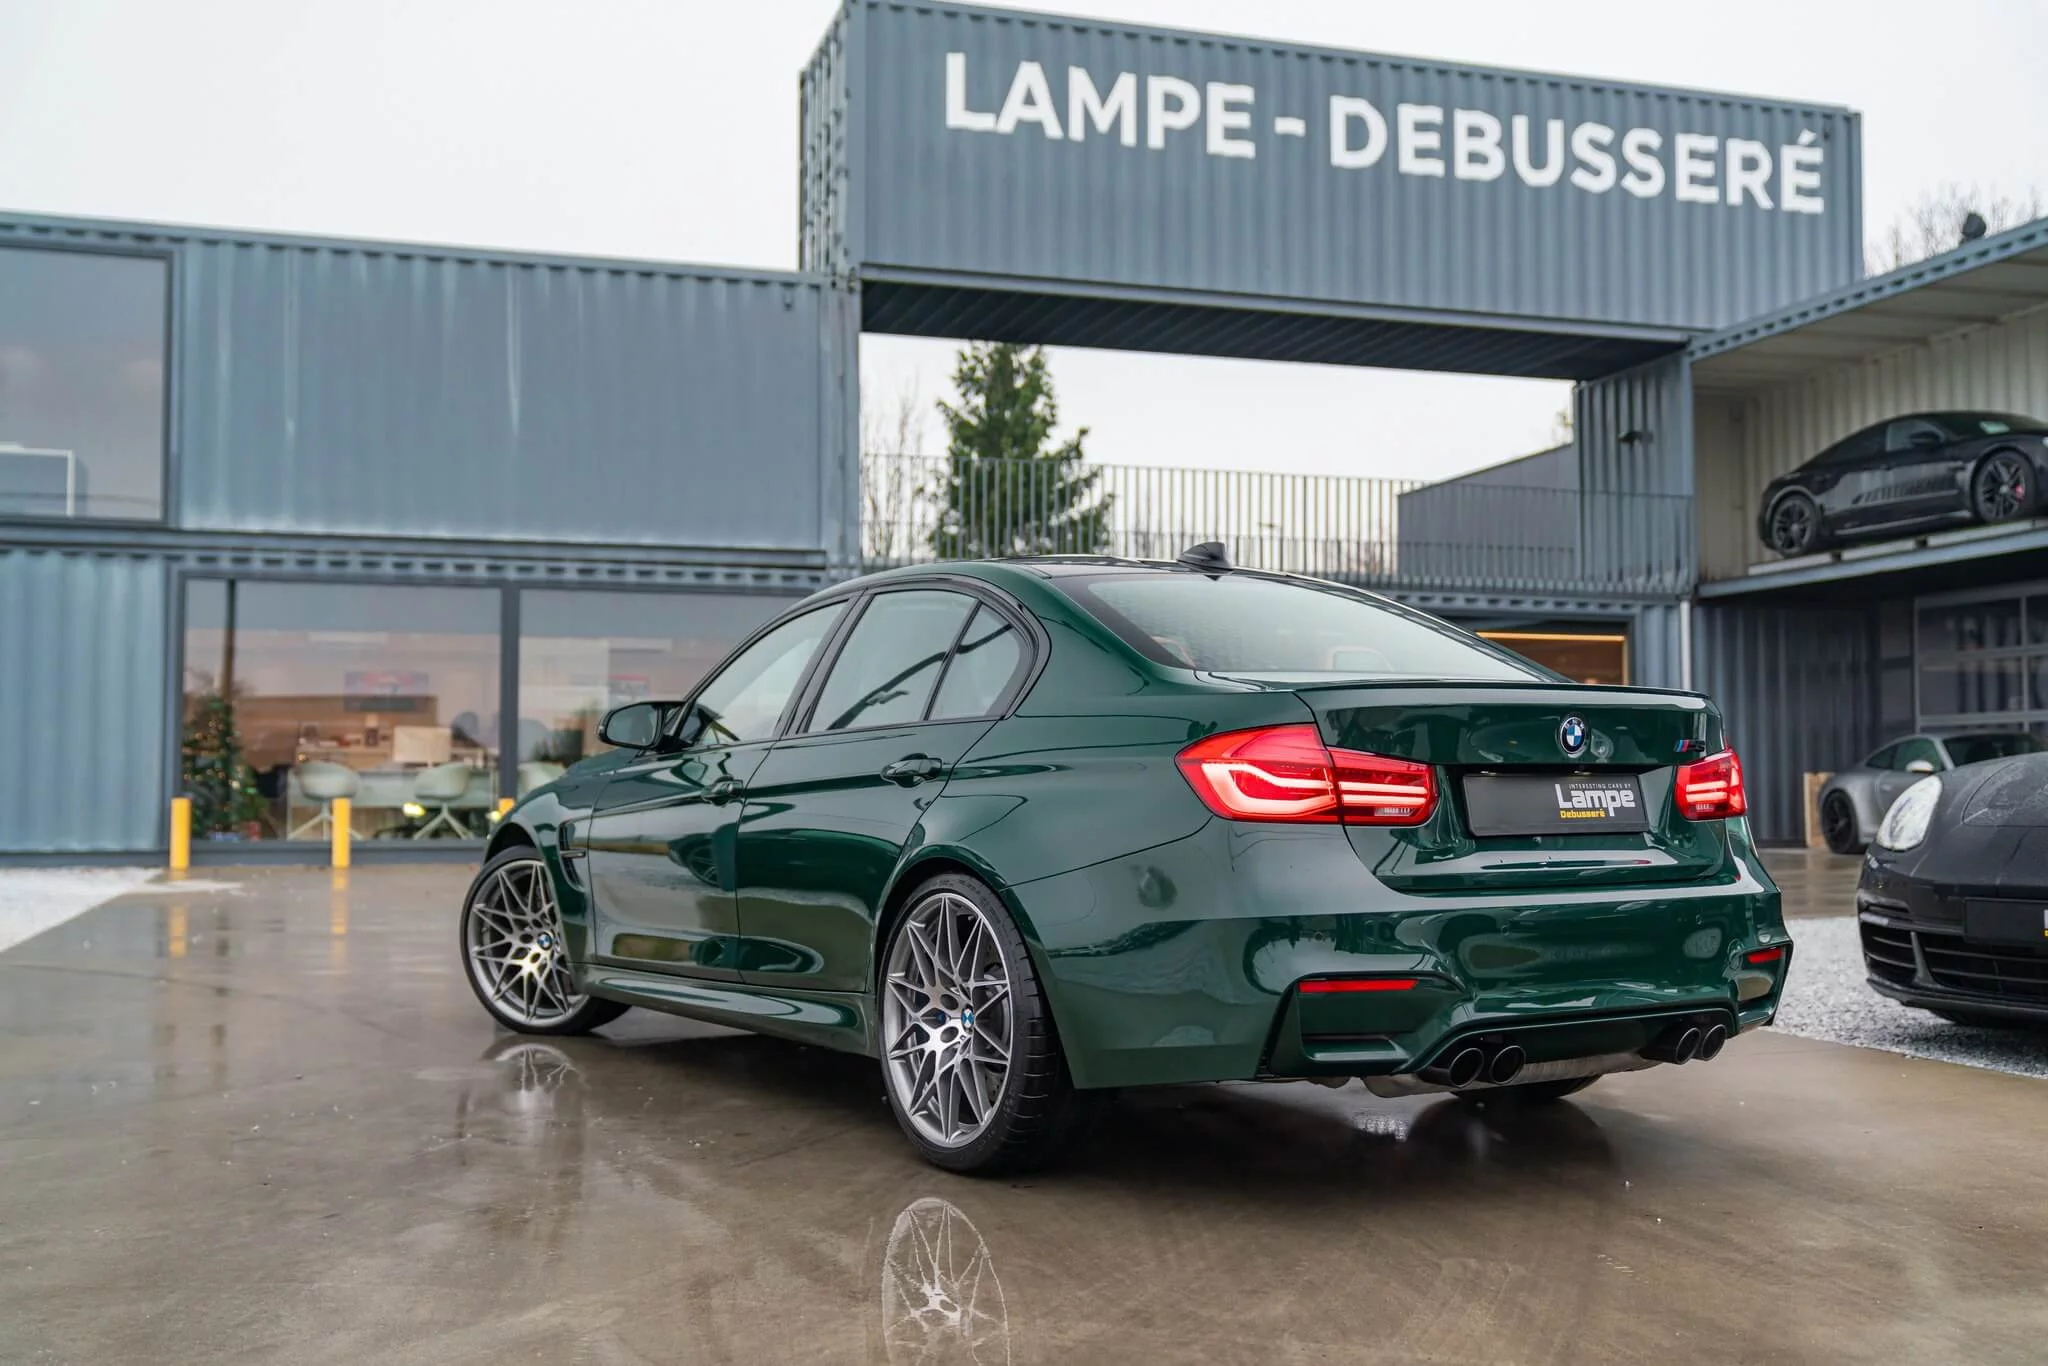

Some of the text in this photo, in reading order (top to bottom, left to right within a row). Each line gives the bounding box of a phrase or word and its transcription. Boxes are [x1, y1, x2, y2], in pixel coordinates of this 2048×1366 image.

[945, 52, 1825, 214] LAMPE - DEBUSSERÉ
[1554, 783, 1636, 817] Lampe
